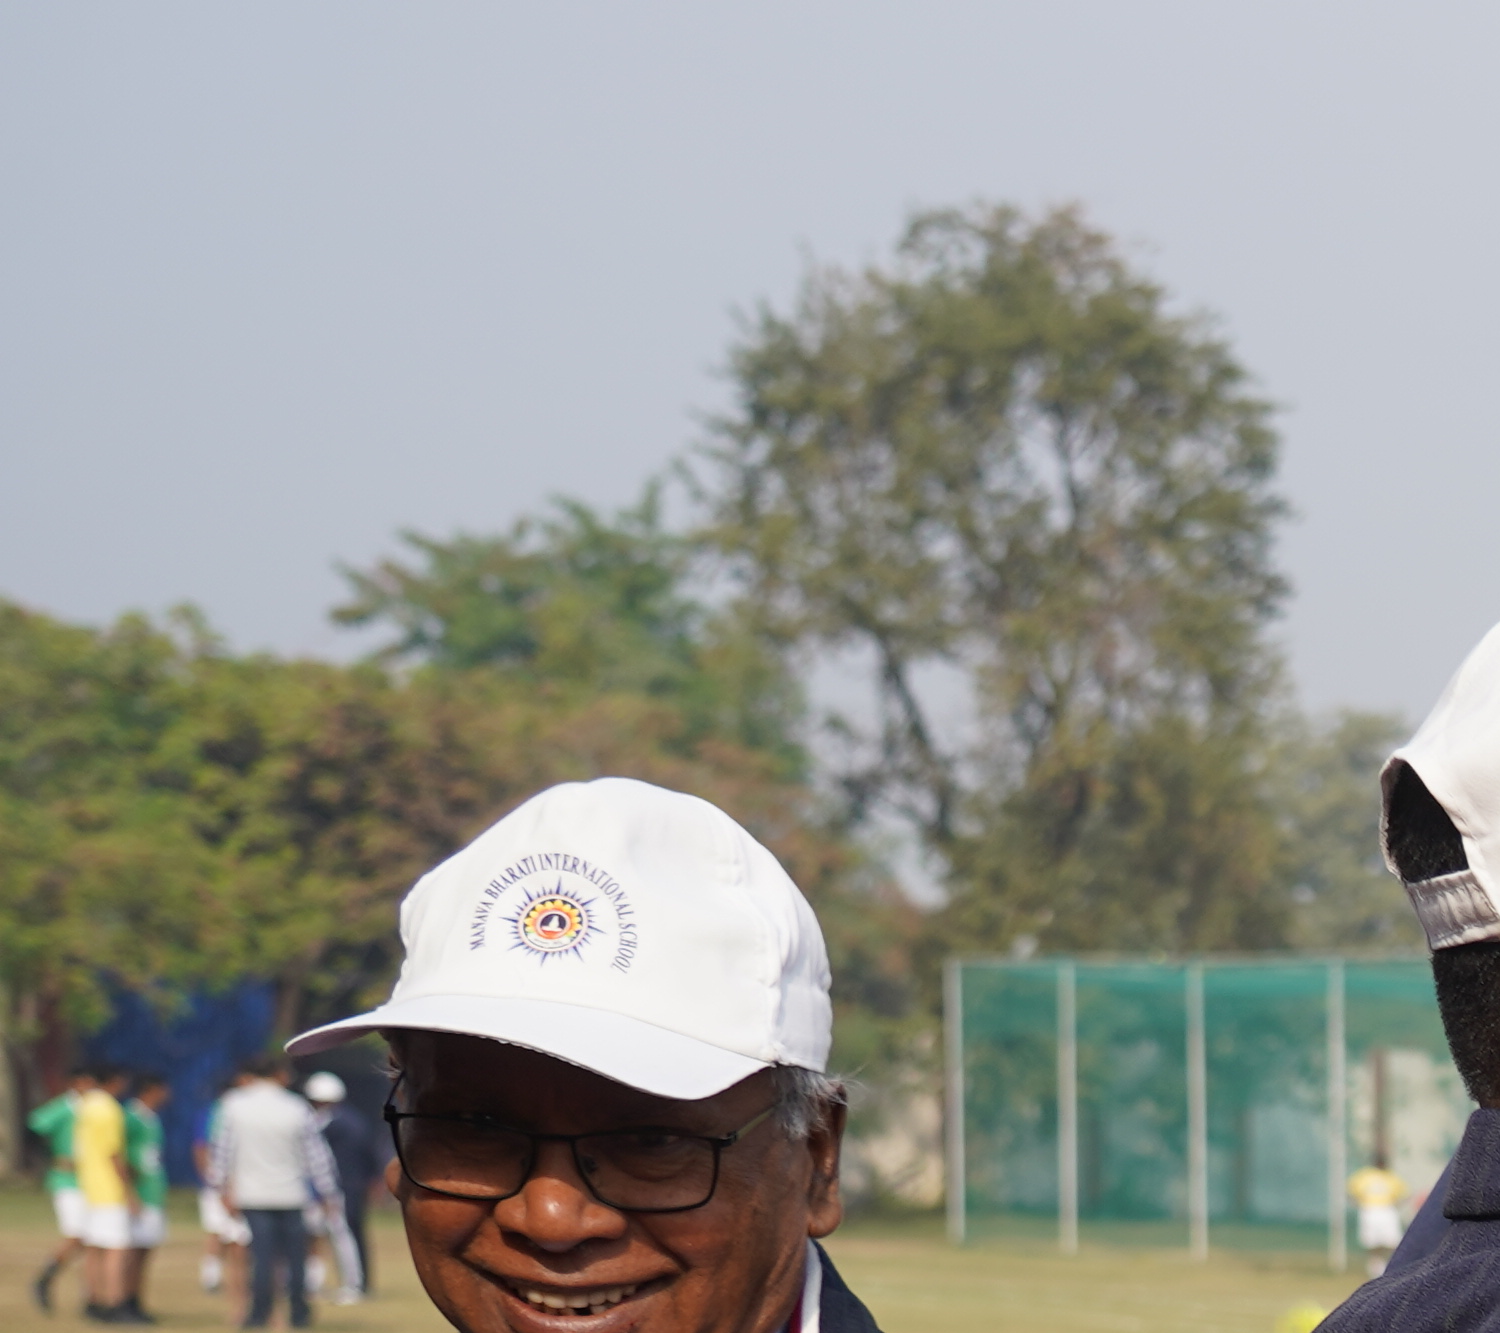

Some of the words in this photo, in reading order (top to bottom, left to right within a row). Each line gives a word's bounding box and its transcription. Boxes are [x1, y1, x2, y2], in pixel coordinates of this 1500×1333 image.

[469, 901, 494, 951] MANAVA
[484, 855, 539, 899] BHARATI
[537, 853, 635, 920] INTERNATIONAL
[610, 922, 638, 974] SCHOOL
